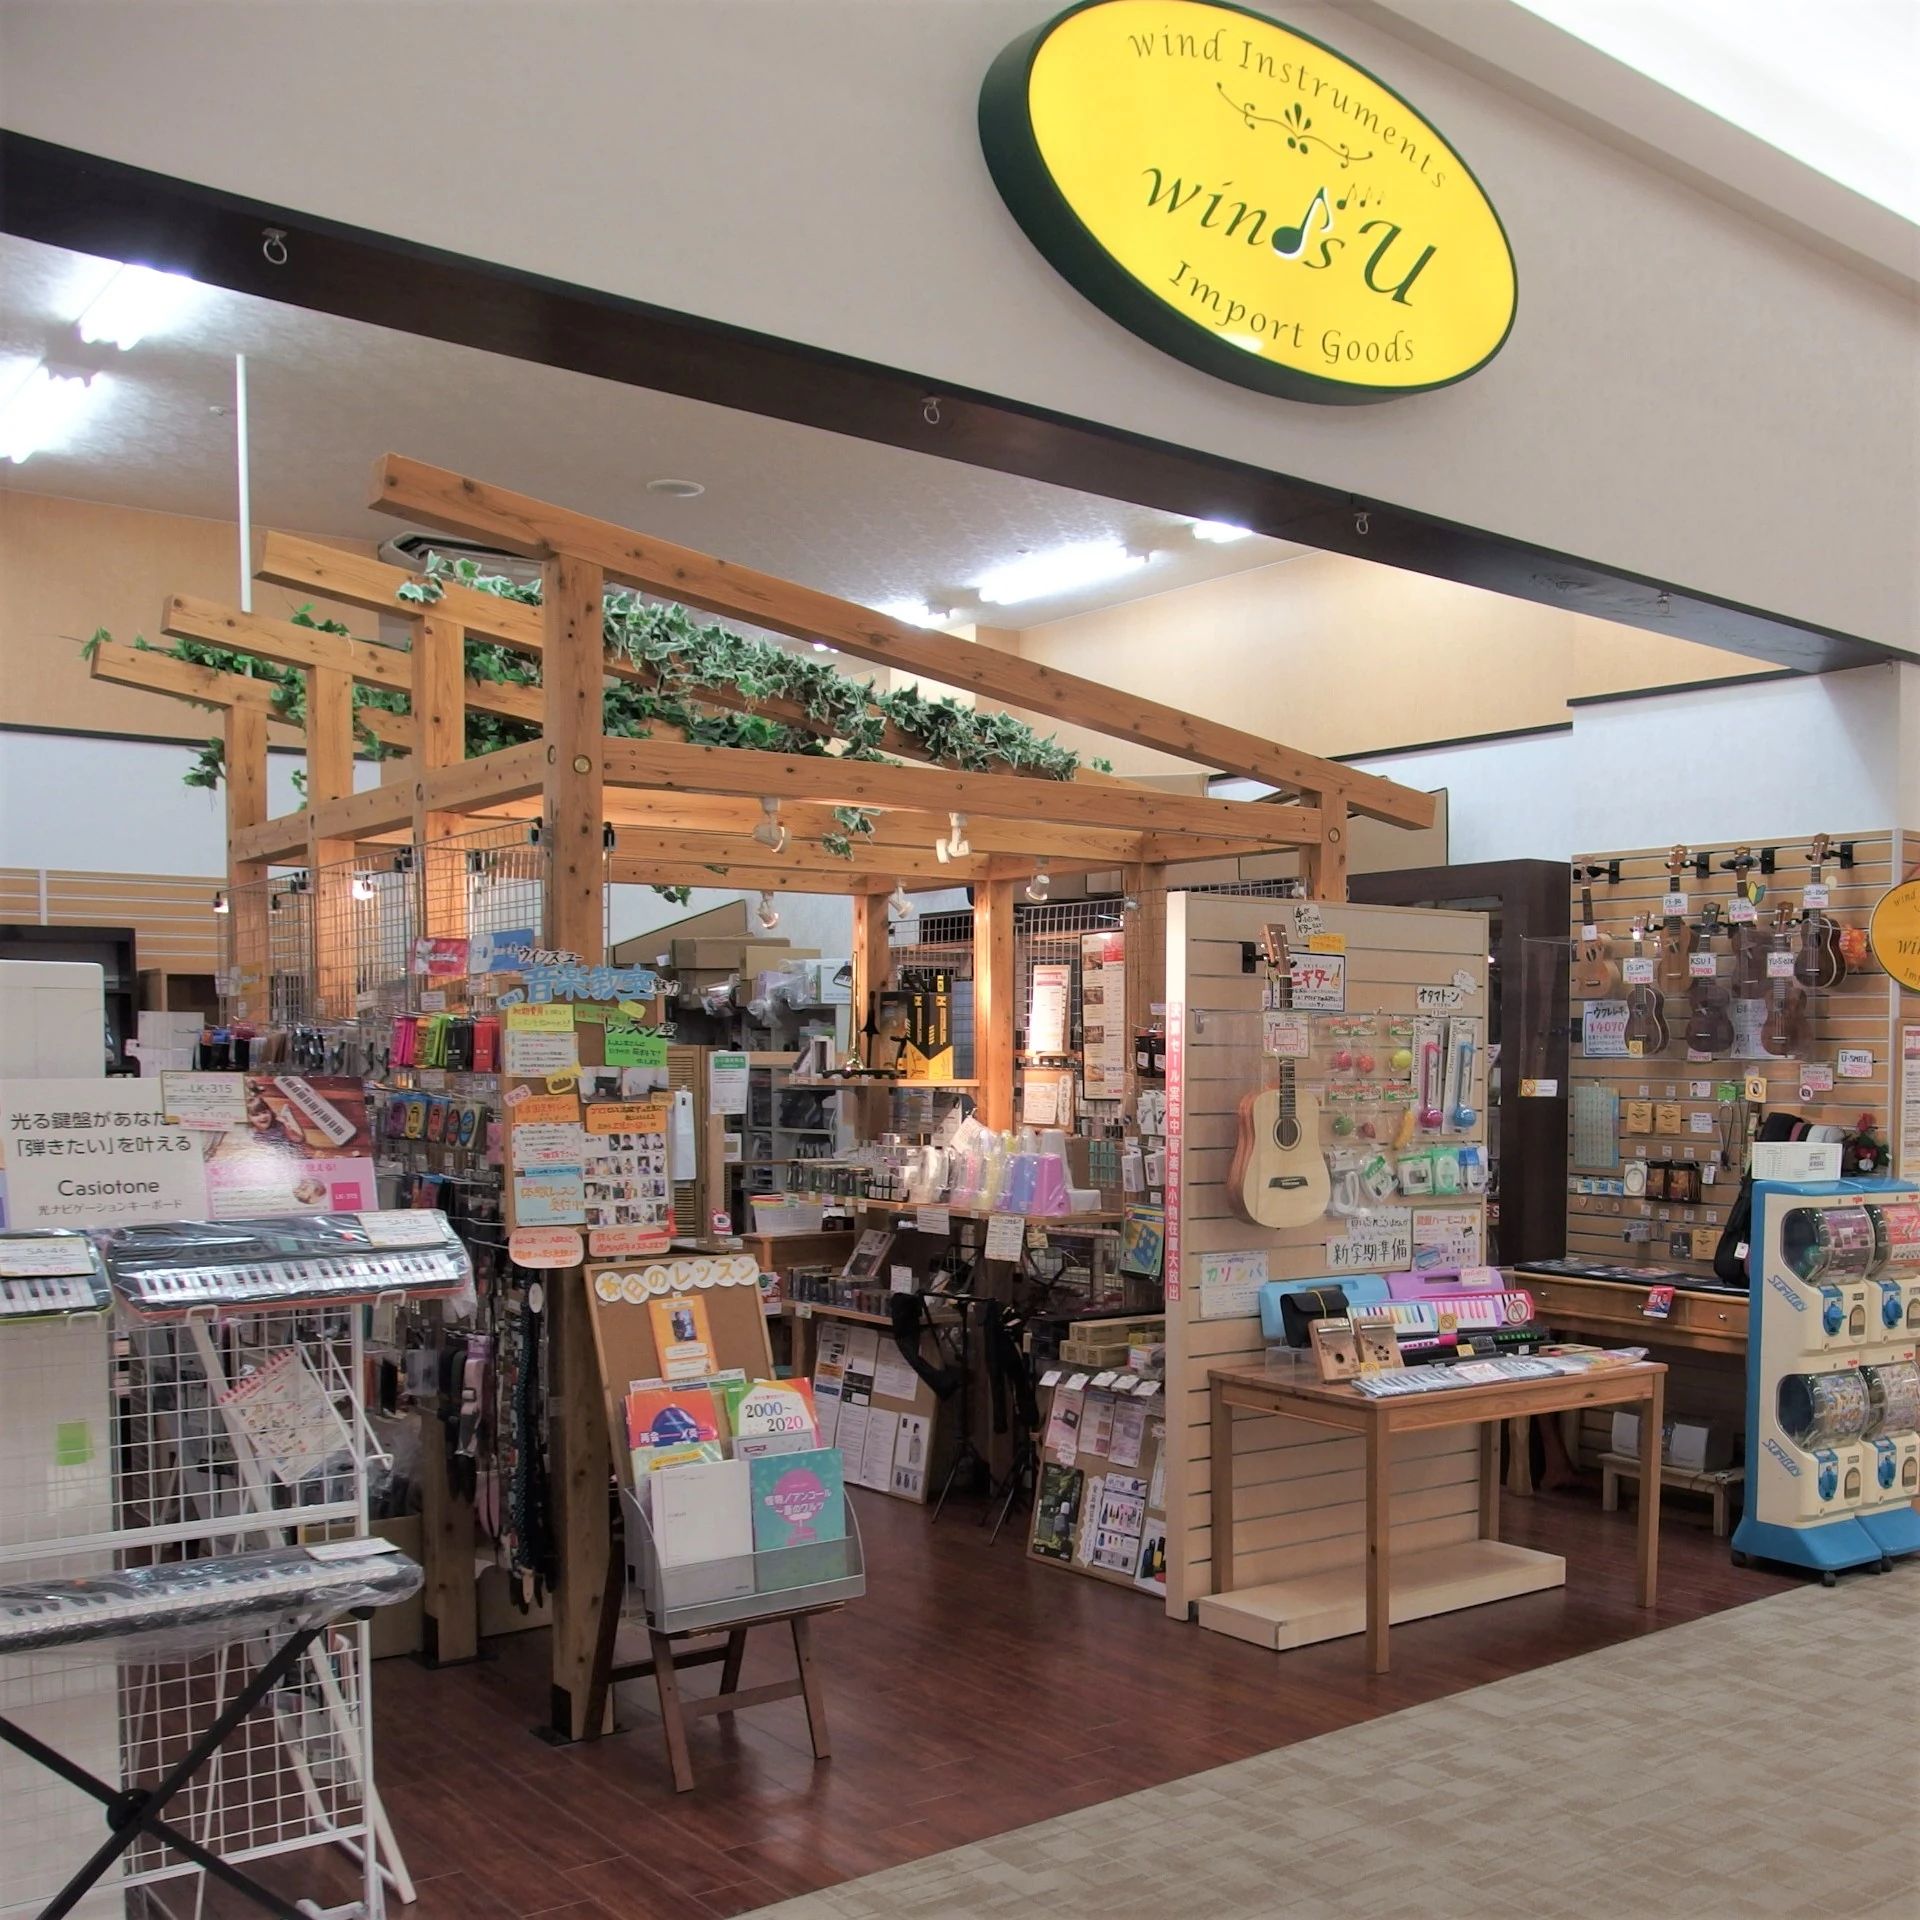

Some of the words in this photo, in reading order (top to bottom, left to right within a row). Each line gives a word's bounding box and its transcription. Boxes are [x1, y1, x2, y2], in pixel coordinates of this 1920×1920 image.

[1128, 24, 1227, 62] wind
[1239, 40, 1448, 189] Instruments
[1168, 260, 1304, 348] Import
[1321, 329, 1415, 365] Goods
[17, 1136, 191, 1156] 「弾きたい」を叶える
[58, 1180, 160, 1196] Casiotone
[38, 1199, 182, 1216] 光ナビゲーションキーボード
[1334, 1238, 1407, 1265] 新学期準備
[767, 1416, 803, 1432] 2020
